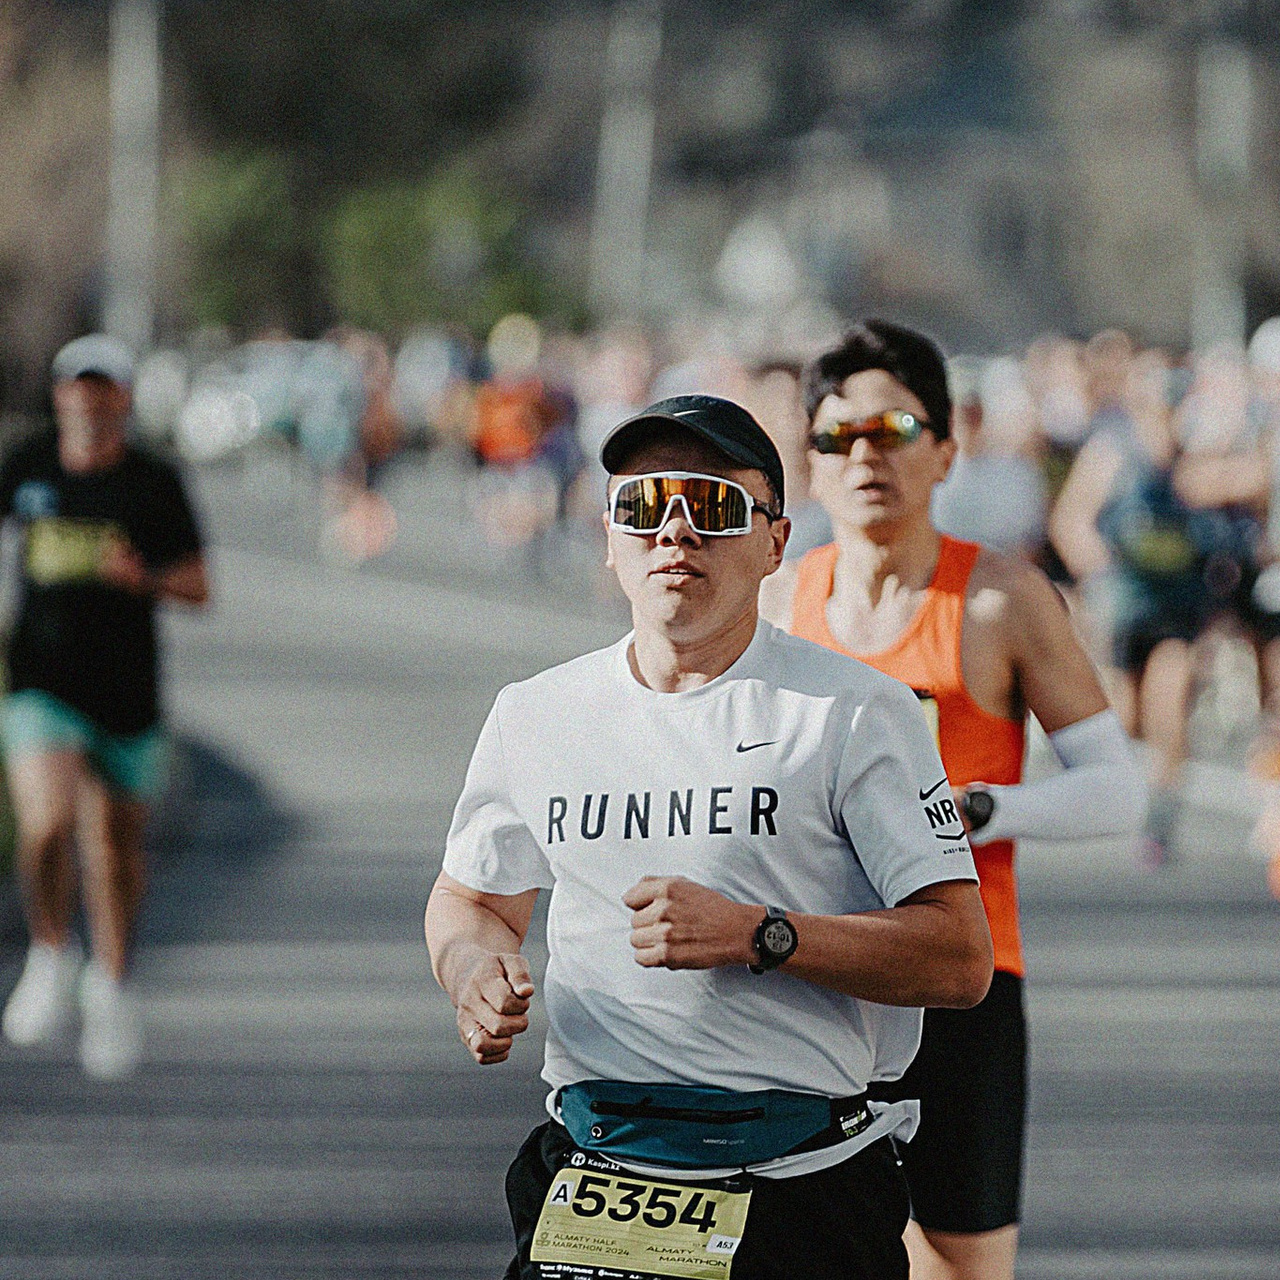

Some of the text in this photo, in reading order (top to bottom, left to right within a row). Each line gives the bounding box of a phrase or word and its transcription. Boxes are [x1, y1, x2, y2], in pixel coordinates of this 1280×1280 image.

[547, 786, 779, 845] RUNNER
[552, 1174, 717, 1234] A 5354
[553, 1233, 617, 1246] ALMATY HALF
[551, 1241, 630, 1257] MARATHON 2024
[645, 1245, 694, 1255] ALMATY
[658, 1255, 728, 1268] MARATHON
